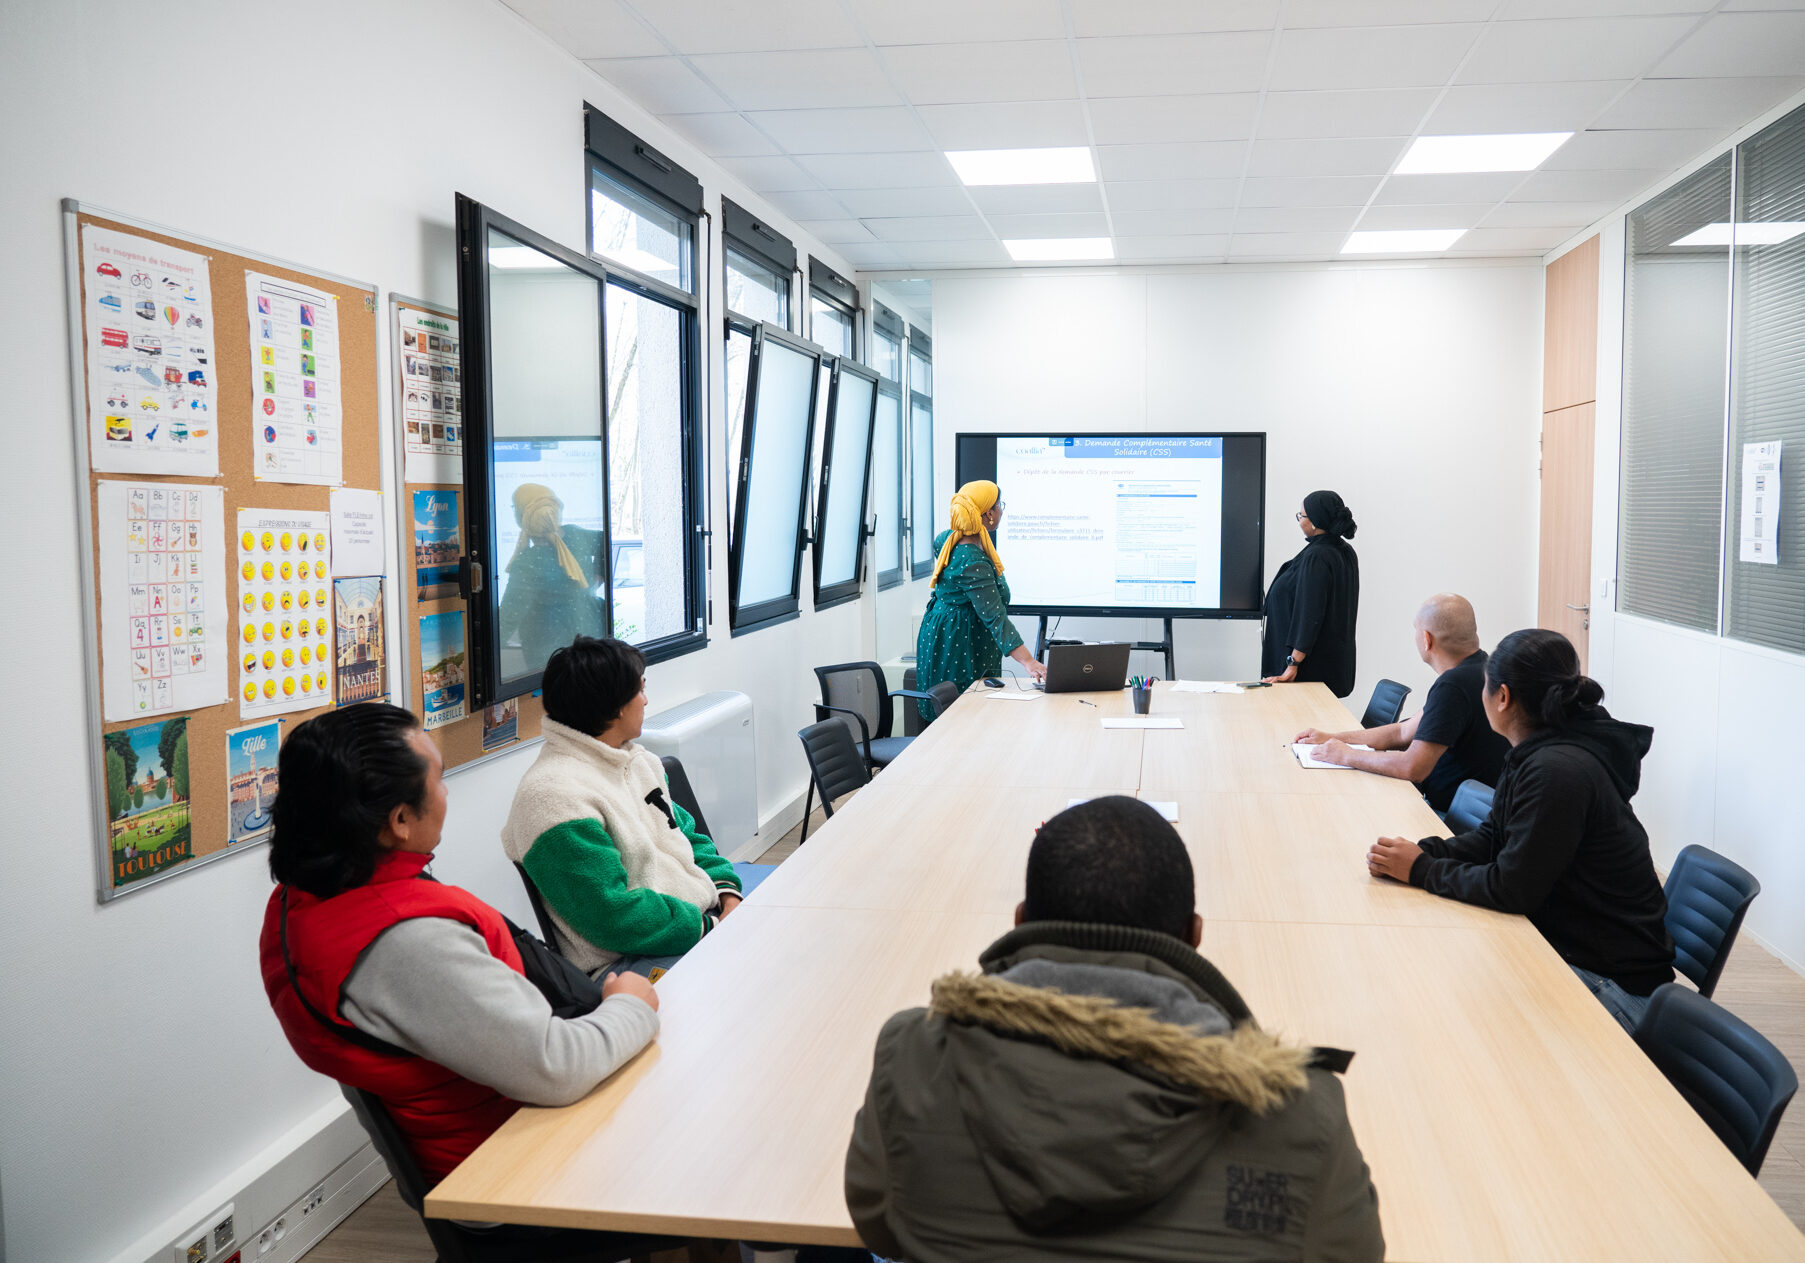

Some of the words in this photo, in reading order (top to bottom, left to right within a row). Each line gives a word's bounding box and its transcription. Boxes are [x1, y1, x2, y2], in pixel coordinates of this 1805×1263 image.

[93, 242, 110, 254] Les
[113, 249, 146, 262] moyens
[148, 256, 158, 265] de
[160, 260, 194, 274] transport
[1084, 439, 1120, 447] Demande
[1123, 439, 1186, 448] Complémentaire
[1189, 439, 1212, 447] Santé
[1150, 448, 1172, 457] (CSS)
[132, 490, 144, 500] Aa
[153, 490, 163, 500] Bb
[172, 492, 181, 501] Cc
[189, 492, 198, 501] Dd
[424, 494, 449, 517] Lyon
[132, 522, 142, 532] Ee
[153, 522, 162, 531] Ff
[171, 522, 181, 534] Gg
[153, 554, 161, 566] Jj
[131, 587, 146, 596] Mm
[153, 586, 162, 595] Nn
[171, 584, 181, 594] Oo
[190, 584, 199, 594] Pp
[154, 617, 163, 626] Rr
[172, 616, 182, 624] Ss
[192, 614, 199, 623] Tt
[134, 618, 146, 629] Qq
[156, 649, 165, 657] Vv
[172, 647, 186, 656] Ww
[192, 645, 200, 654] Xx
[135, 651, 146, 660] Uu
[157, 680, 166, 689] Zz
[343, 671, 380, 690] NANTES
[137, 682, 147, 693] Yy
[427, 707, 462, 726] MARSEILLE
[241, 734, 267, 756] Lille
[118, 841, 186, 877] TOULOUSE
